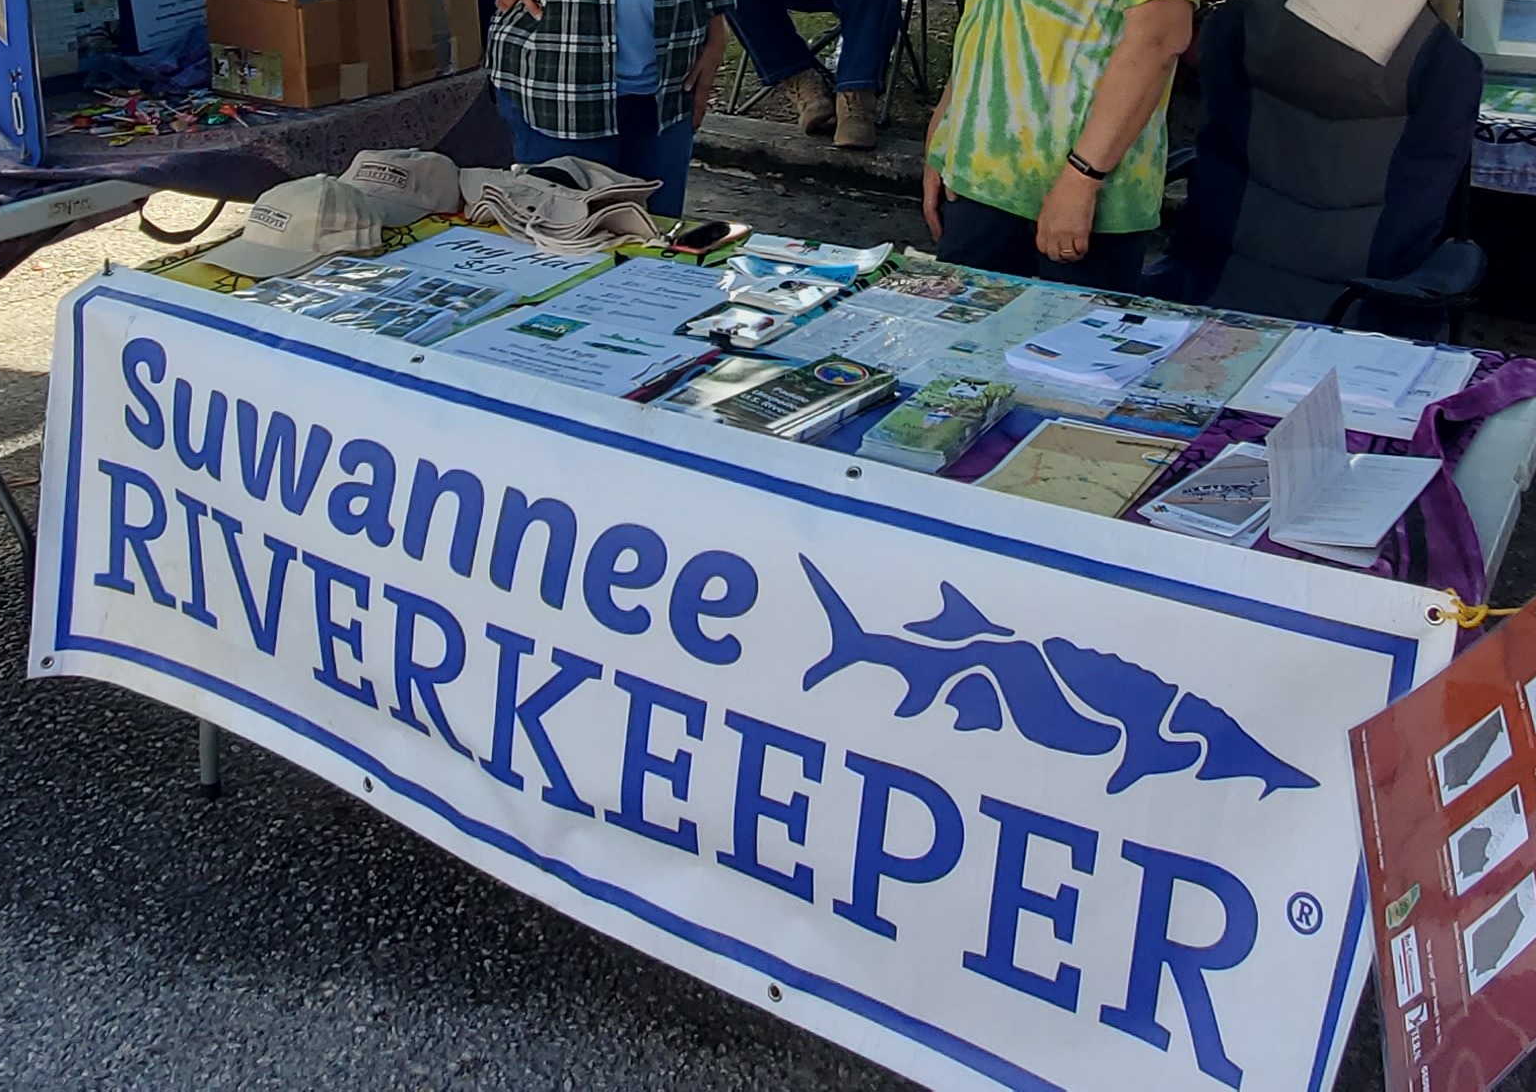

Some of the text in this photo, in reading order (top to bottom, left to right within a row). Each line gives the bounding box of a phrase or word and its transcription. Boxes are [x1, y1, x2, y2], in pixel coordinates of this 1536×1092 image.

[435, 239, 592, 271] Any Hat
[122, 337, 759, 666] Suwannee
[93, 459, 1259, 1091] RIVERKEEPER
